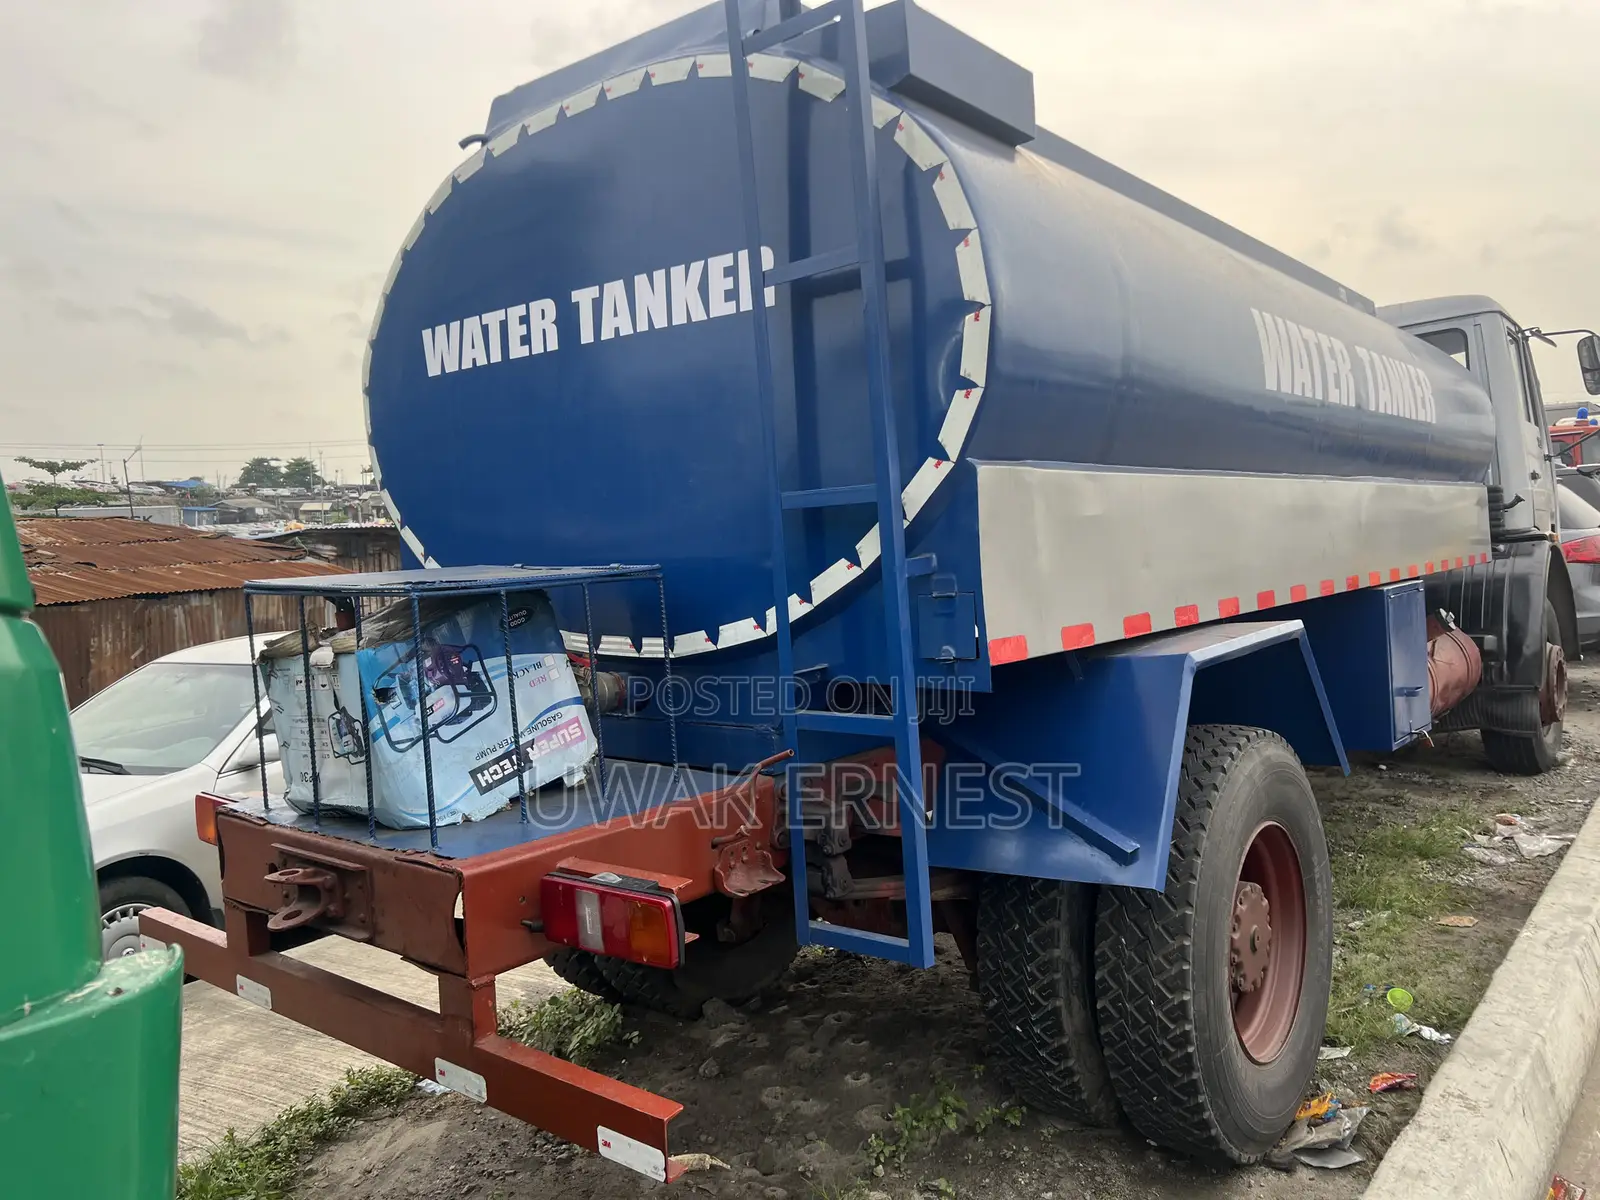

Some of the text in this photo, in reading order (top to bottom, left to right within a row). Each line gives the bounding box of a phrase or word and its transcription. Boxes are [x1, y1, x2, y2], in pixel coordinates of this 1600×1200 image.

[421, 245, 775, 378] WATER TANKER
[1250, 307, 1436, 424] WATER TANKER
[507, 609, 527, 622] QUALIT
[512, 661, 543, 679] BLACK
[529, 675, 547, 688] RED
[526, 711, 563, 736] GASOLINE
[474, 747, 498, 761] PUMP
[476, 722, 582, 788] SUPER TECH
[601, 1139, 611, 1149] 3M
